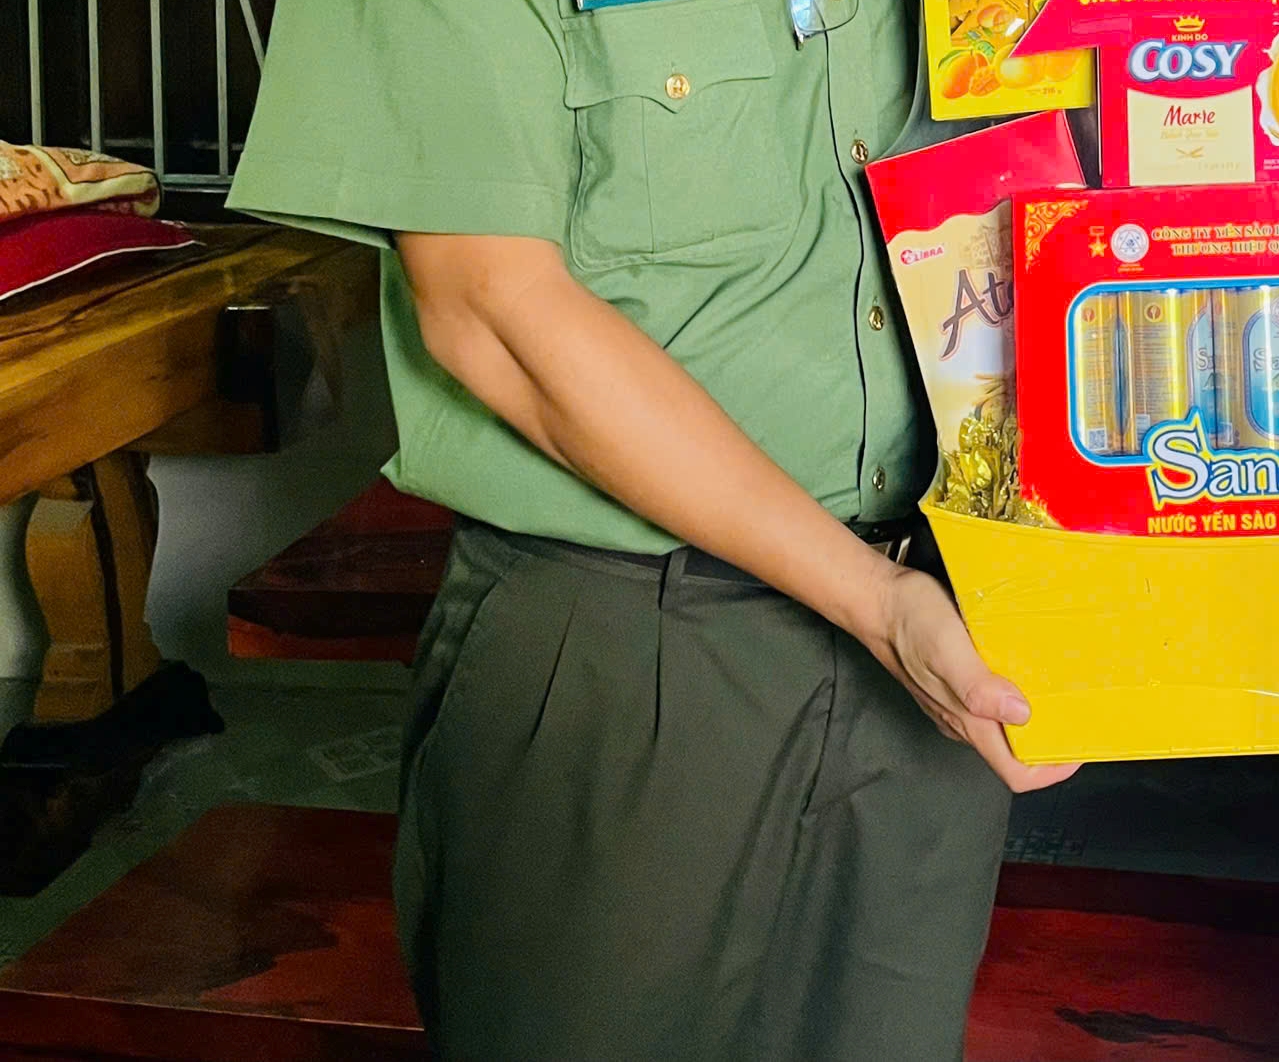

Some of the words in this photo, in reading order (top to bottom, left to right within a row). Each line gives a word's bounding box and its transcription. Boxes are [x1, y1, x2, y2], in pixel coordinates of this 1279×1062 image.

[1171, 34, 1193, 42] KINH
[1129, 39, 1247, 83] COSY
[1163, 105, 1216, 126] Marie
[1151, 226, 1191, 240] CÔNG
[1192, 226, 1210, 238] TY
[1244, 220, 1273, 237] SÀO
[1148, 511, 1197, 533] NƯỚC
[1201, 509, 1236, 531] YẾN
[1241, 509, 1277, 530] SÀO
